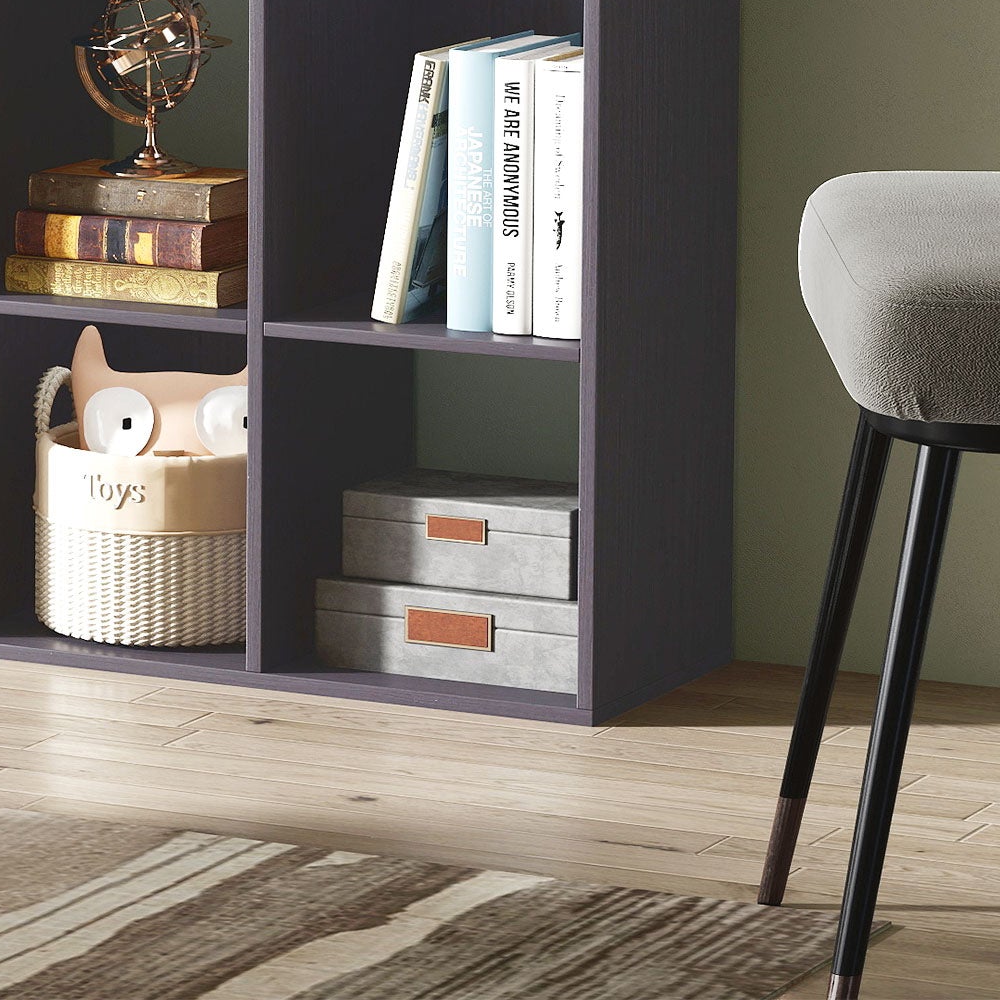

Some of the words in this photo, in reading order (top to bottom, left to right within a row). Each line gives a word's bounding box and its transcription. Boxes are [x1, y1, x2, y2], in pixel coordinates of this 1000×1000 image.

[419, 60, 436, 104] FRANK
[503, 82, 520, 103] WE
[503, 109, 520, 138] ARE
[552, 94, 567, 143] Dreaming
[467, 126, 482, 227] JAPANESE
[482, 168, 493, 189] THE
[502, 143, 520, 238] ANONYMOUS
[553, 160, 566, 199] Sweden
[453, 123, 467, 278] ARCHITECTURE
[482, 190, 493, 212] ART
[482, 213, 493, 228] OF
[505, 262, 516, 288] PARMY
[554, 262, 566, 293] Andrew
[506, 290, 516, 315] OLSON
[83, 474, 147, 510] Toys
